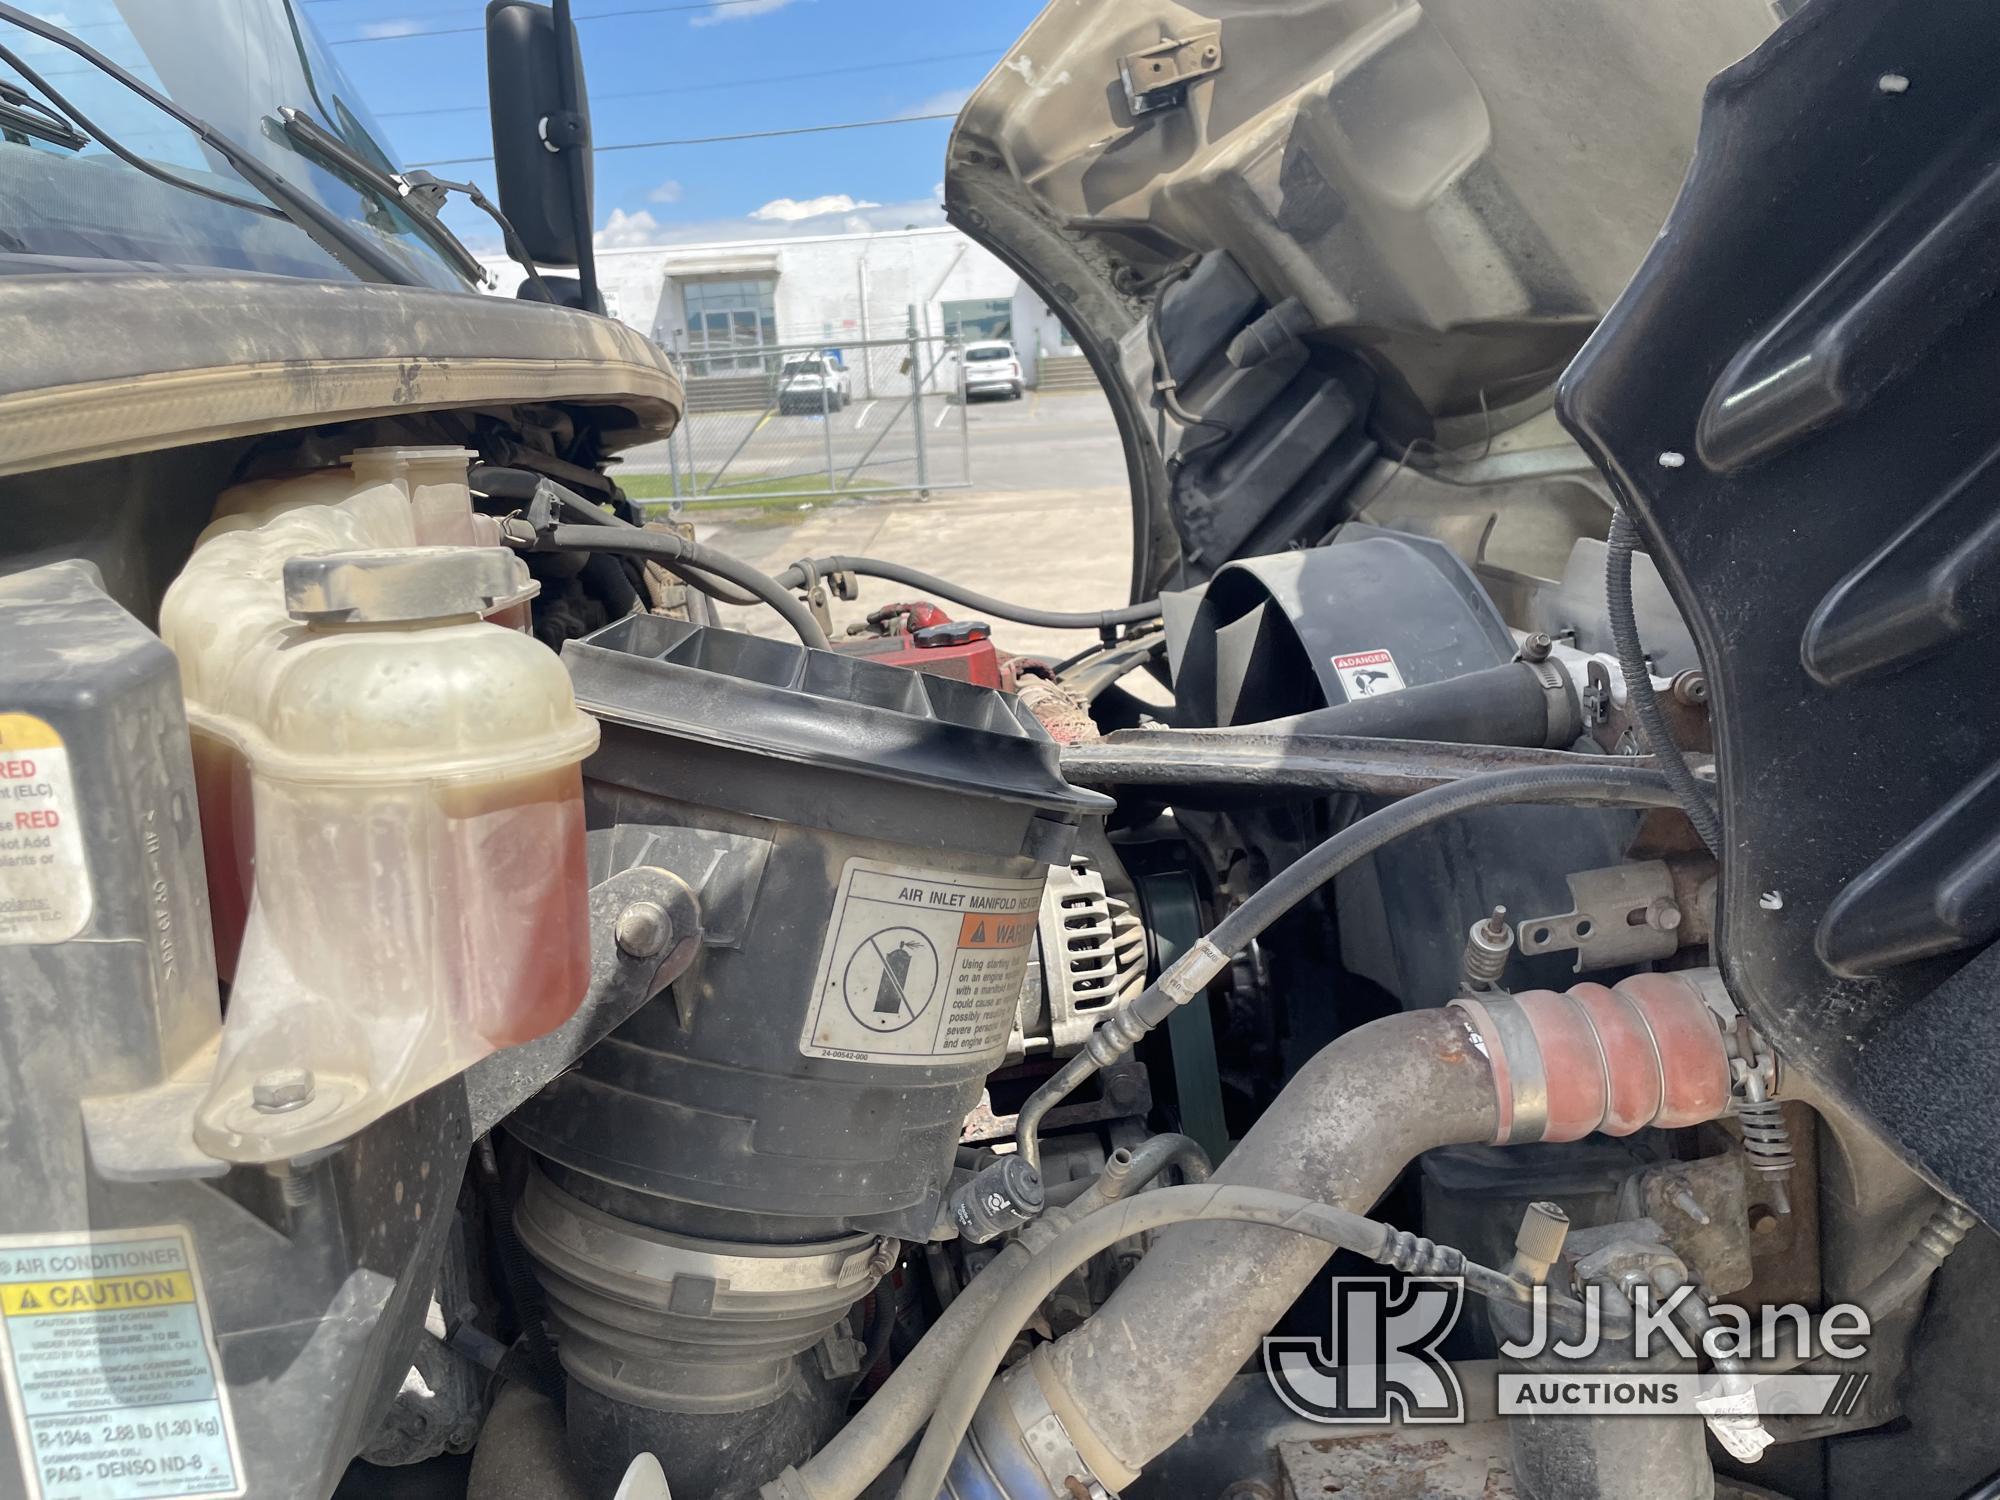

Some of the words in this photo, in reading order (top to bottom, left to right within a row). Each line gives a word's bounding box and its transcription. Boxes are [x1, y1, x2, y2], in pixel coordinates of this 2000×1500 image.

[1347, 653, 1389, 667] DANGER
[14, 784, 54, 800] (ELC)
[16, 810, 59, 830] RED
[24, 835, 51, 849] Add
[898, 887, 923, 902] AIR
[929, 891, 966, 907] INLET
[969, 896, 1016, 910] MANIFOLD
[962, 959, 984, 971] Using
[987, 959, 1009, 970] starting
[959, 974, 969, 982] on
[972, 973, 981, 982] an
[983, 973, 1004, 983] engine
[957, 985, 972, 995] with
[981, 984, 1006, 994] manifold
[953, 999, 973, 1009] could
[976, 999, 994, 1008] cause
[949, 1010, 981, 1024] possibly
[946, 1026, 972, 1035] severe
[943, 1040, 959, 1048] and
[961, 1037, 983, 1048] engine
[15, 1257, 46, 1275] AIR
[49, 1246, 182, 1273] CONDITIONER
[49, 1278, 175, 1308] CAUTION
[38, 1429, 92, 1448] R-134a
[103, 1425, 134, 1442] 2.88
[137, 1423, 152, 1439] lb
[155, 1419, 192, 1440] (1.30
[195, 1415, 219, 1437] kg)
[45, 1465, 81, 1486] PAG
[96, 1458, 156, 1480] DENSO
[161, 1454, 202, 1474] ND-8
